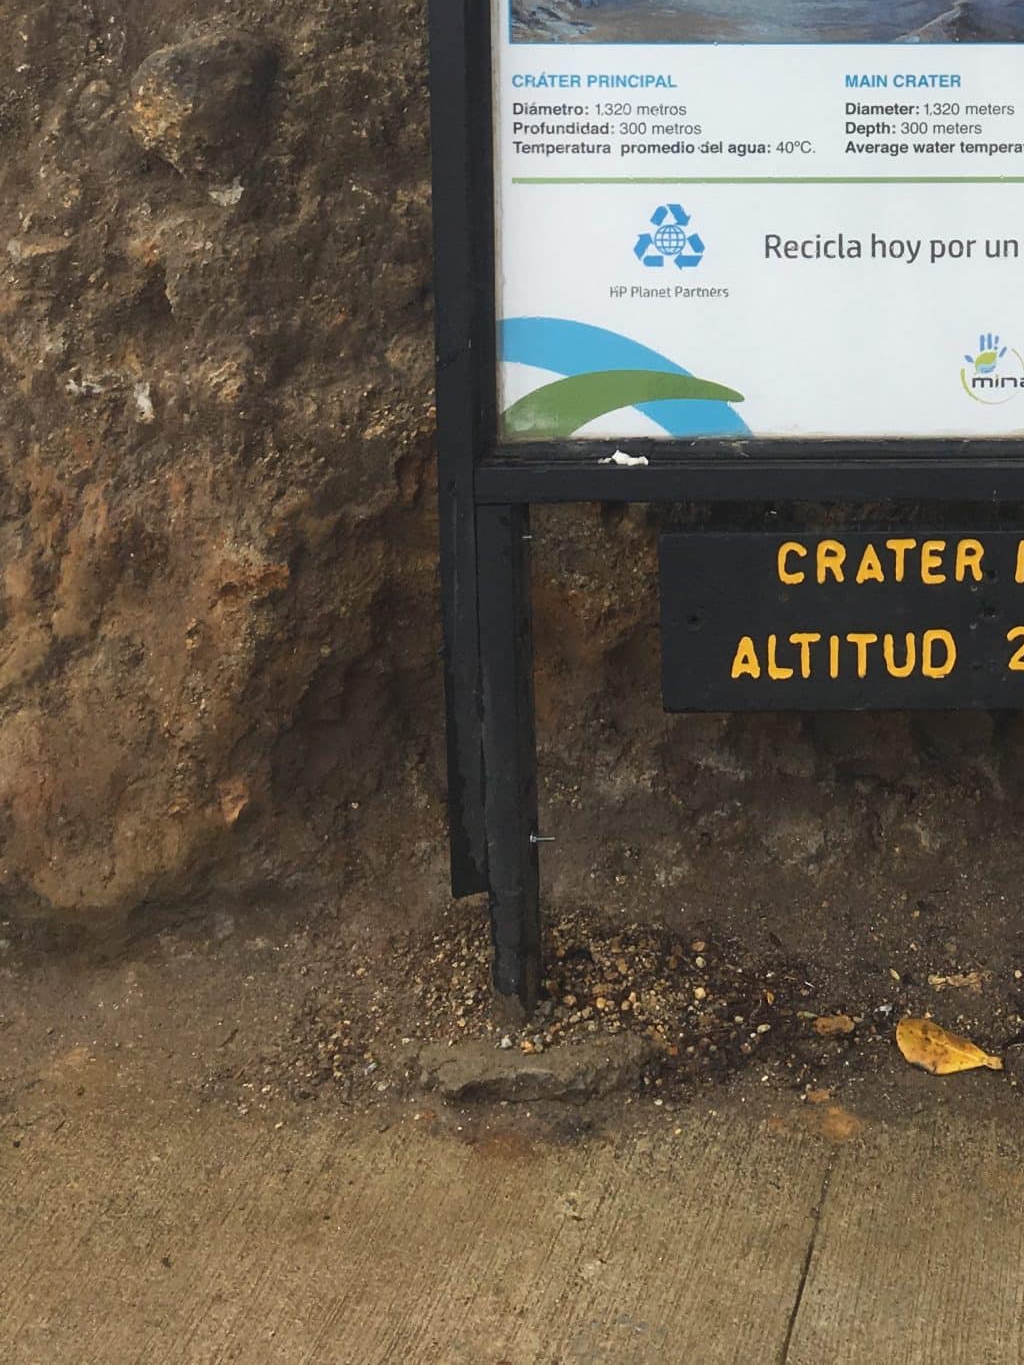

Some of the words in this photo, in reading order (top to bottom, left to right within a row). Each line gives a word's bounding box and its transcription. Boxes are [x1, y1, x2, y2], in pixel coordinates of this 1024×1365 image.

[511, 72, 581, 89] CRÁTER
[587, 73, 678, 89] PRINCIPAL
[844, 74, 888, 88] MAIN
[892, 74, 962, 89] CRATER
[512, 102, 590, 117] Diámetro:
[637, 103, 687, 116] metros
[844, 102, 920, 116] Diameter:
[965, 103, 1015, 116] meters
[512, 121, 616, 136] Profundidad:
[619, 121, 647, 135] 300
[652, 122, 703, 135] metros
[844, 121, 897, 138] Depth:
[900, 121, 928, 135] 300
[932, 122, 983, 135] meters
[512, 140, 611, 158] Temperatura
[620, 140, 695, 158] promedio
[699, 140, 723, 154] del
[727, 142, 772, 158] agua:
[844, 140, 910, 158] Average
[913, 141, 956, 154] water
[764, 232, 862, 260] Recicla
[870, 232, 922, 265] hoy
[929, 238, 977, 265] por
[985, 238, 1019, 259] un
[609, 285, 628, 299] HP
[631, 285, 671, 299] Planet
[675, 285, 730, 299] Partners
[777, 538, 985, 585] CRATER
[730, 629, 957, 680] ALTITUD
